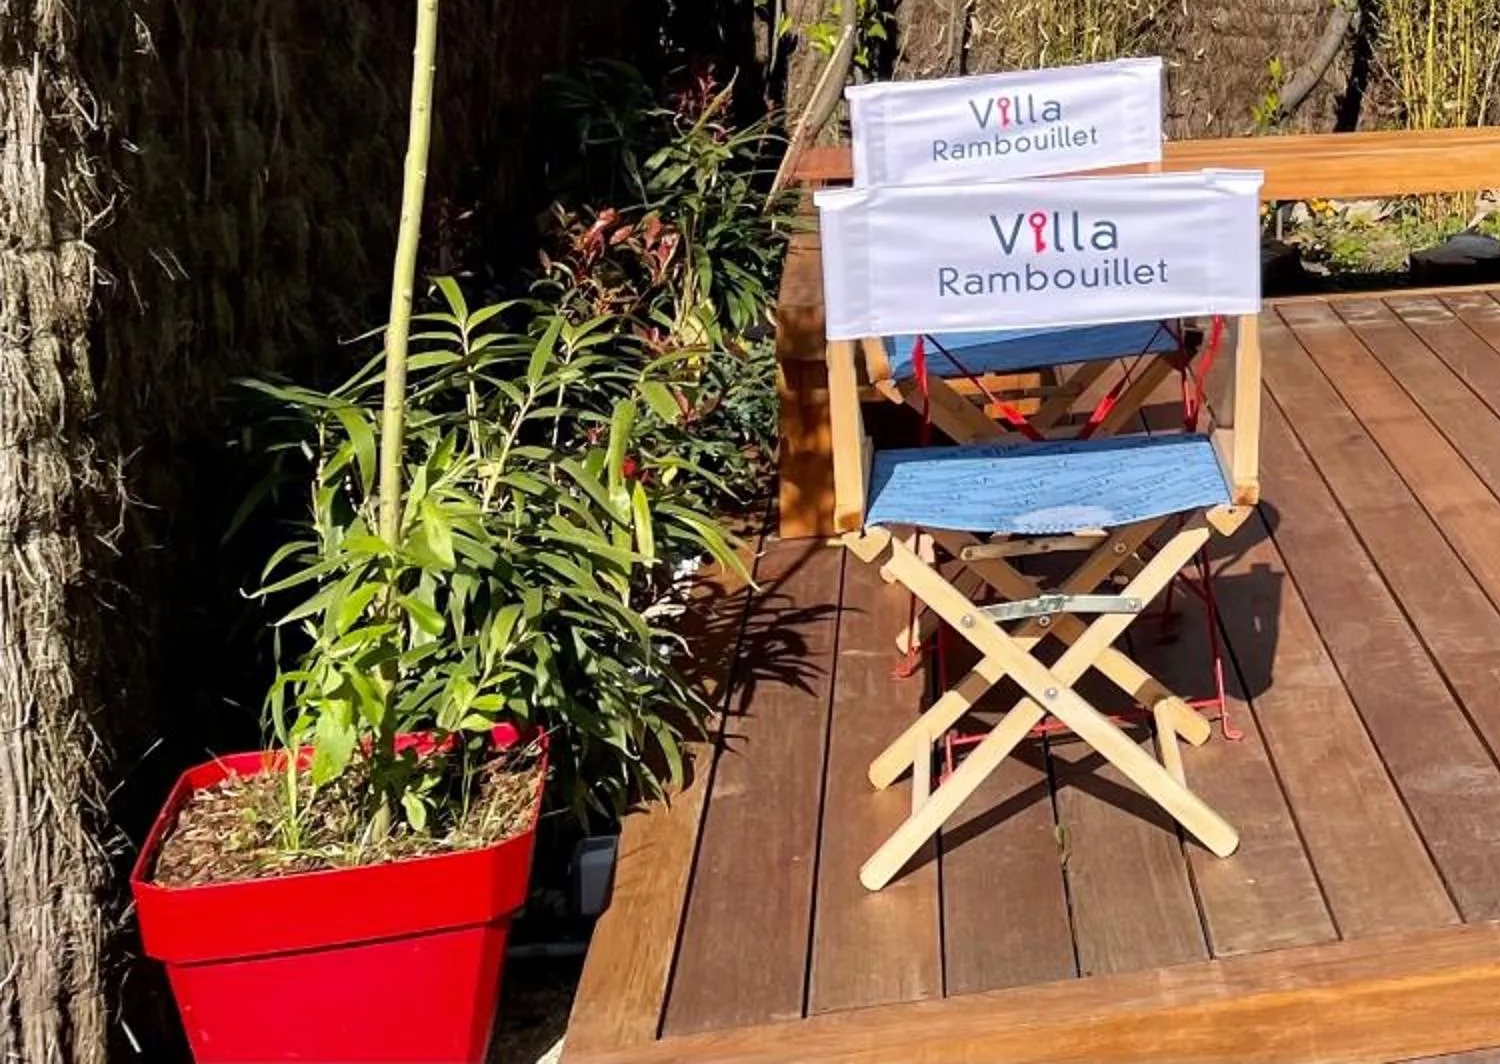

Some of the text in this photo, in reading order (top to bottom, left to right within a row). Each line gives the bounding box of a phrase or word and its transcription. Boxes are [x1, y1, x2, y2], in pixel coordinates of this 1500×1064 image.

[969, 94, 1062, 128] Villa
[933, 126, 1098, 162] Rambouillet
[990, 210, 1119, 254] Villa
[939, 259, 1168, 297] Rambouillet
